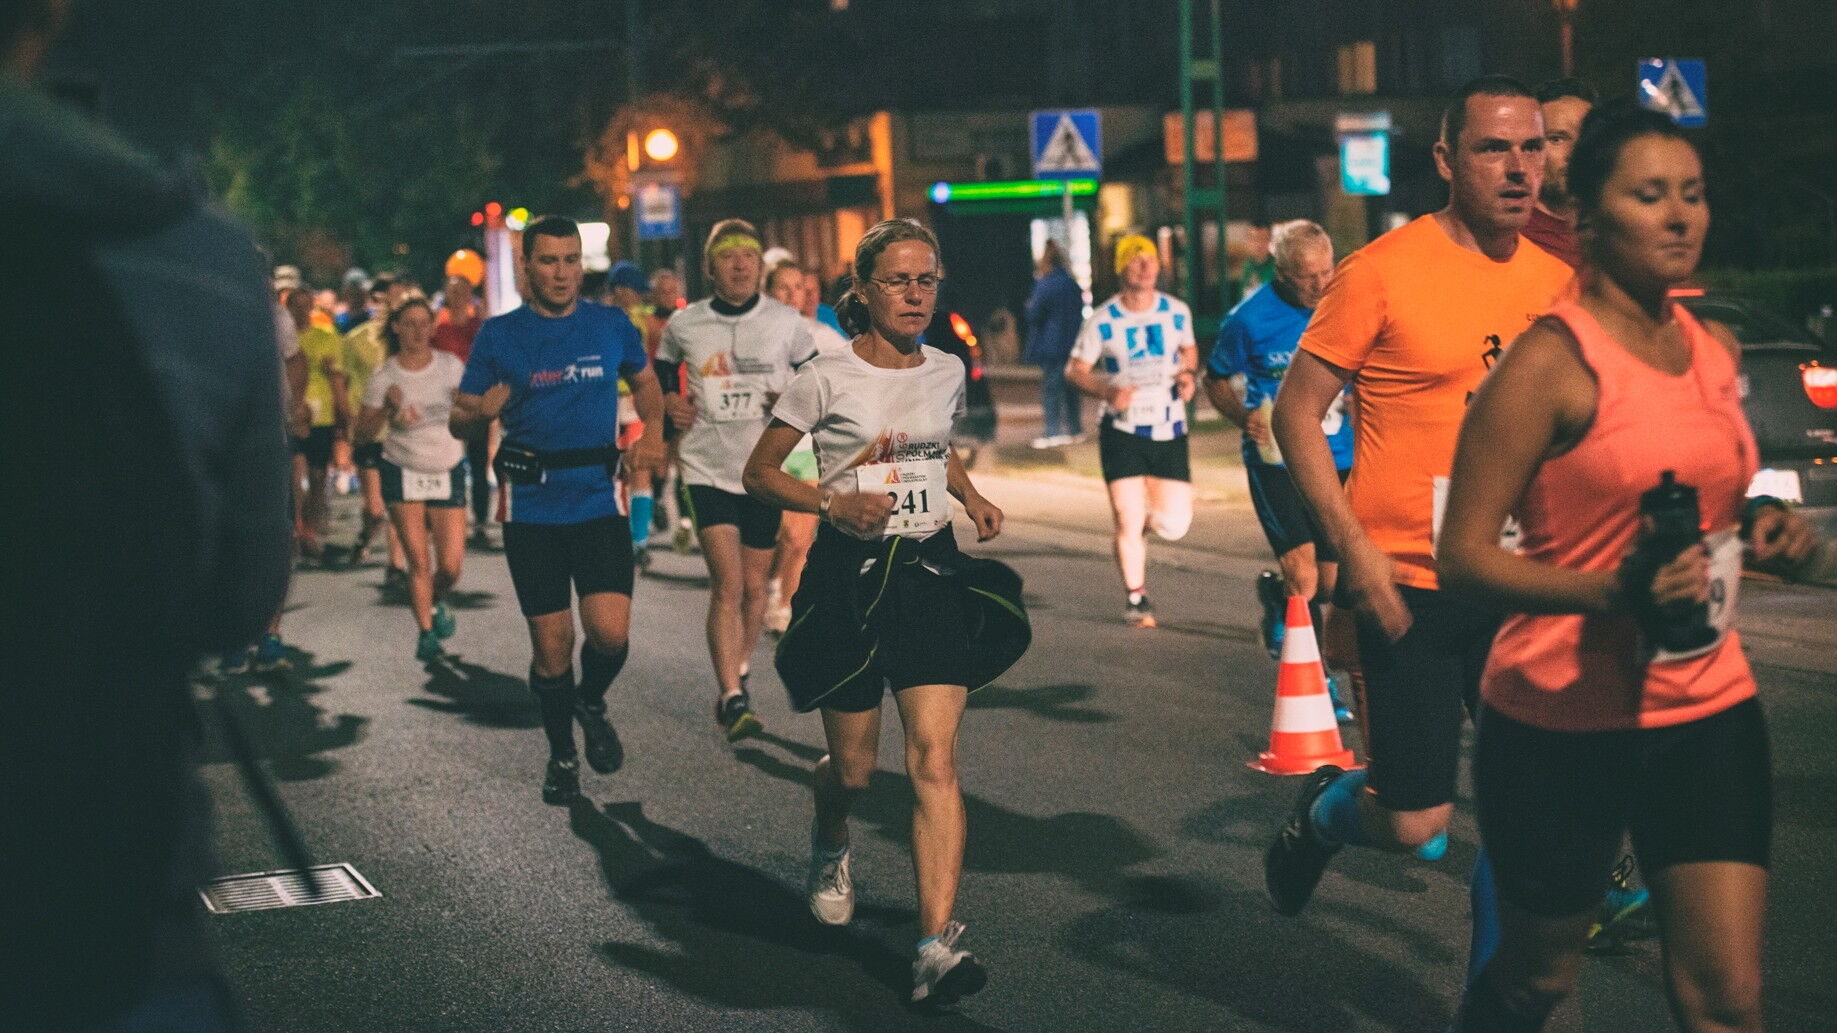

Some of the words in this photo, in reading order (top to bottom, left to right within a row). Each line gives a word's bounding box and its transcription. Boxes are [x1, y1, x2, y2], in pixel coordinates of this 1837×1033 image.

[581, 366, 604, 379] run
[720, 392, 753, 411] 377
[907, 441, 941, 451] RUDZKI
[887, 489, 931, 515] 241
